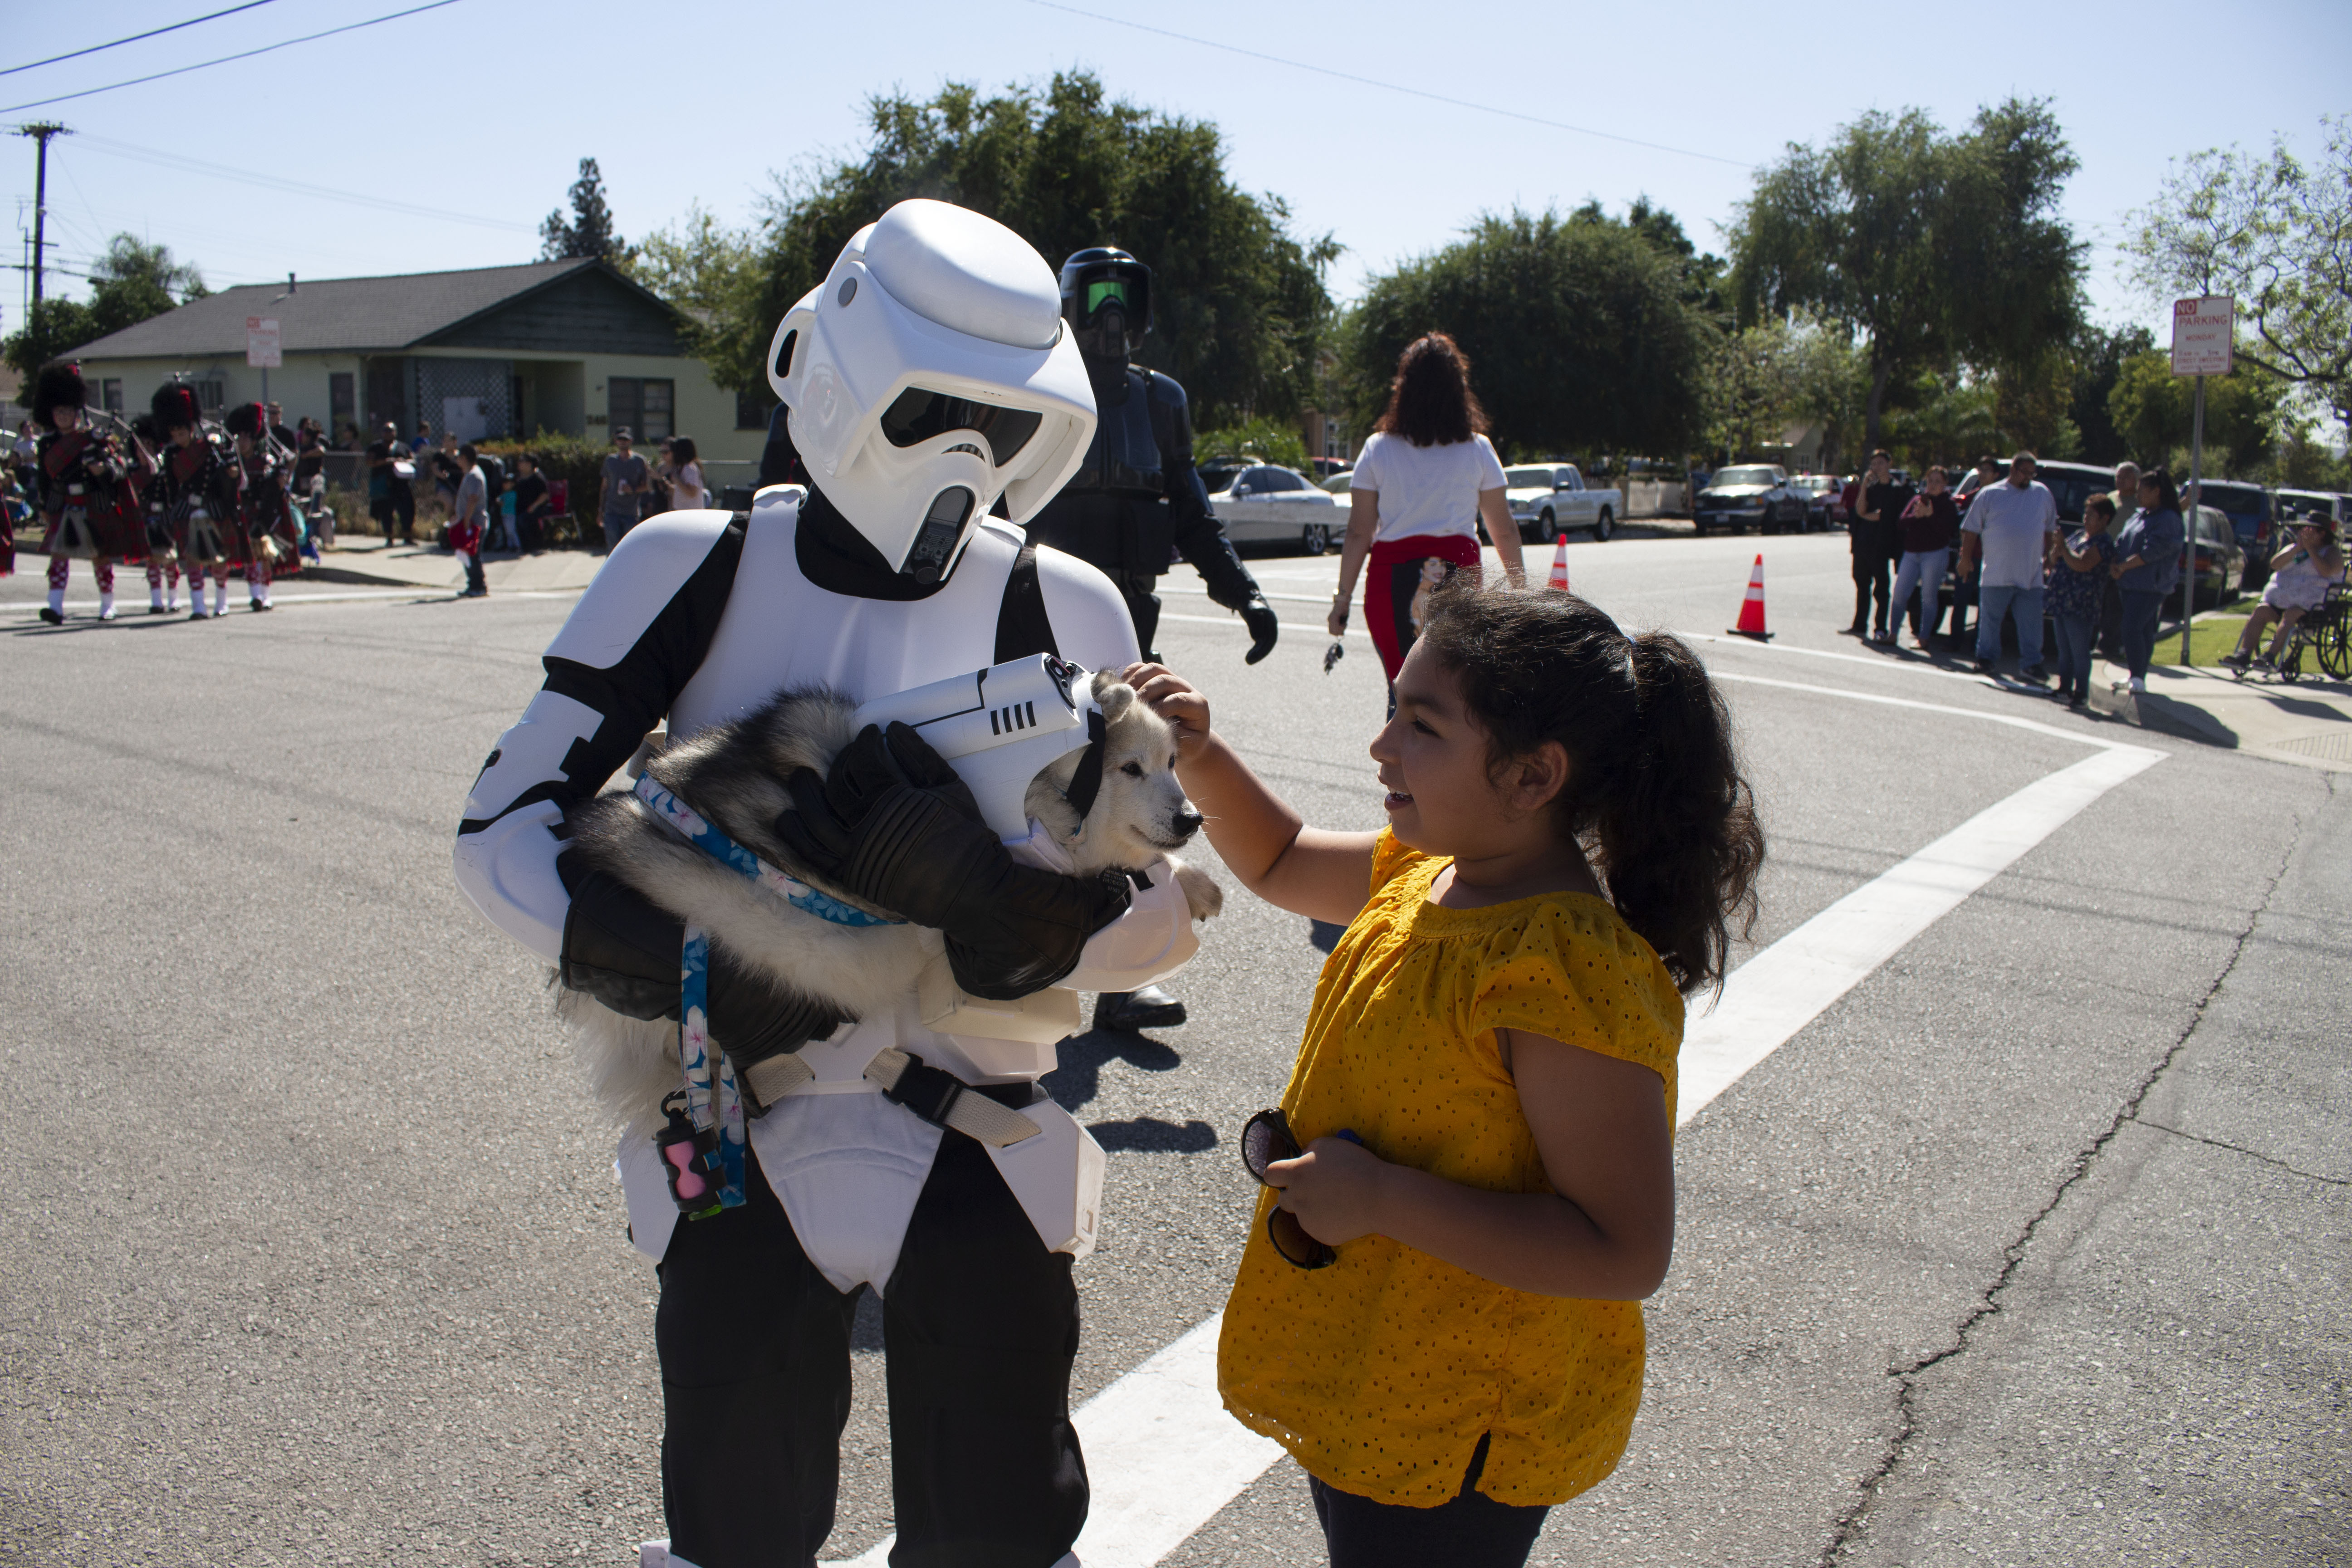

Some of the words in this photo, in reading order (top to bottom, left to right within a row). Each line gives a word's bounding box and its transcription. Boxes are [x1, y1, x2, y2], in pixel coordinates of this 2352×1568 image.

[2177, 302, 2195, 314] NO
[2179, 314, 2227, 327] PARKING
[2185, 333, 2216, 341] MONDAY
